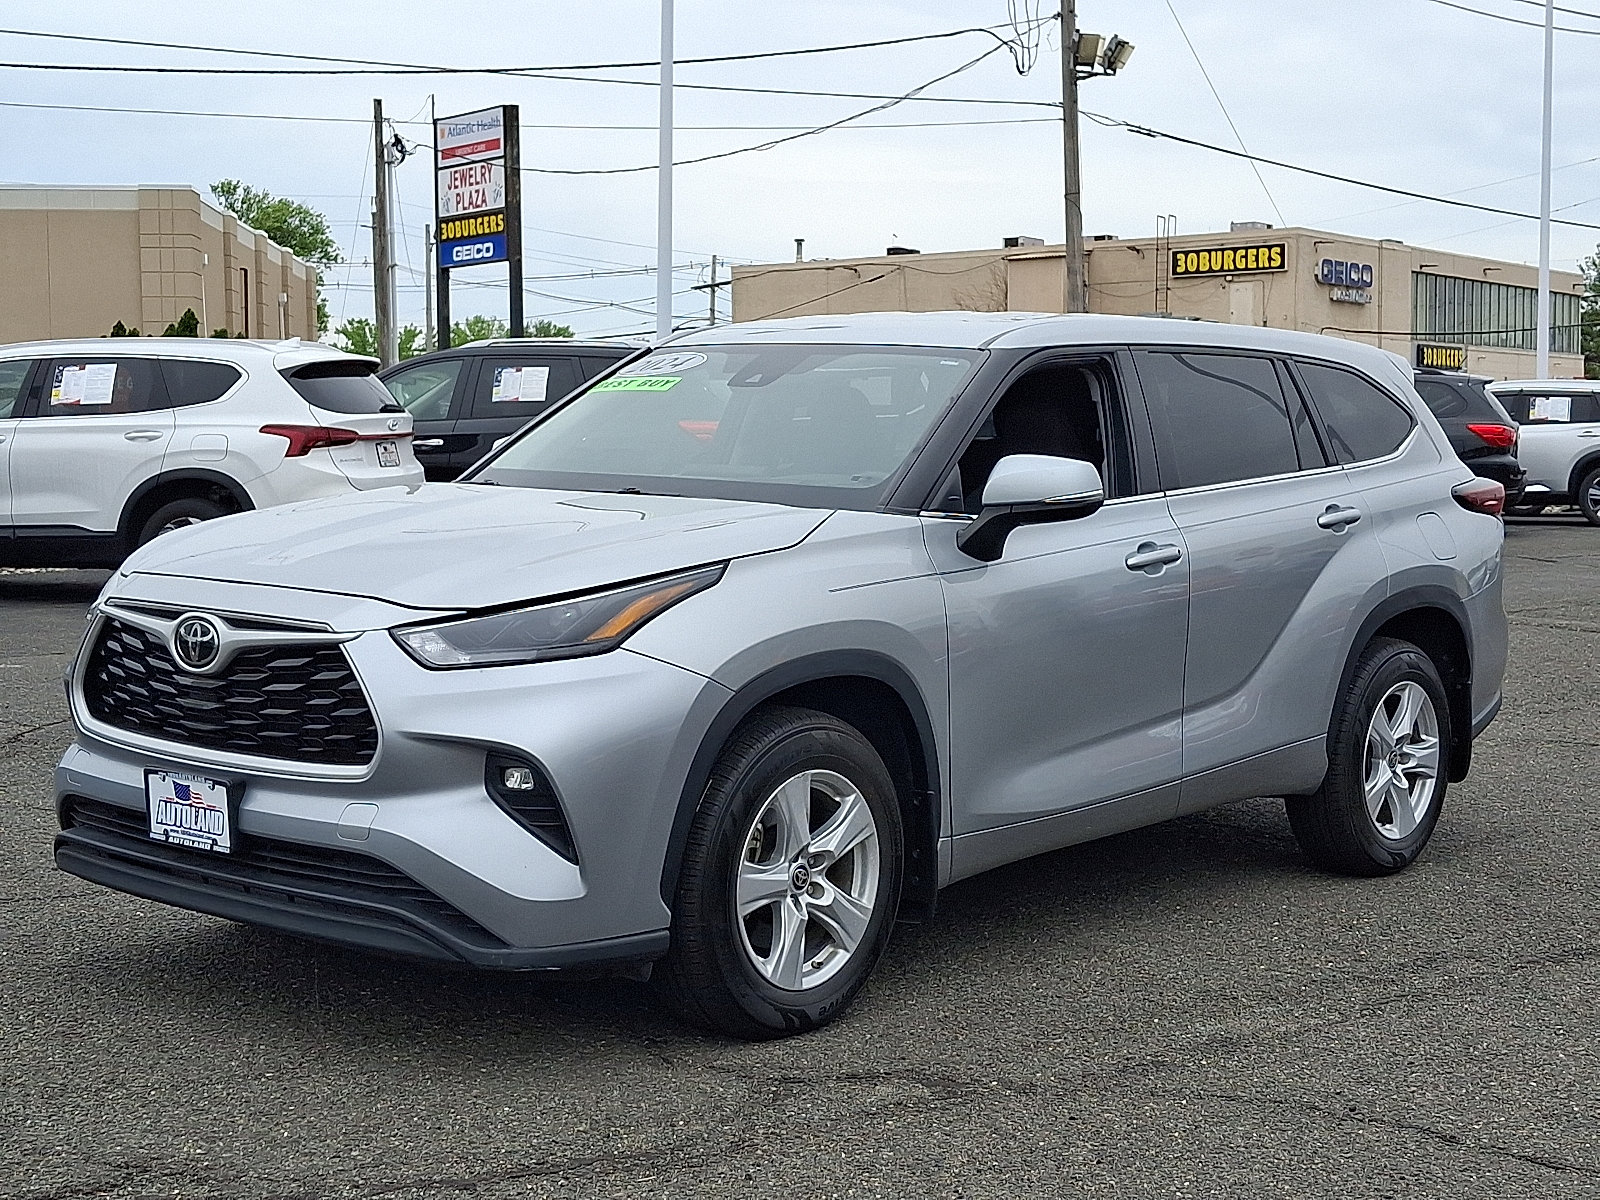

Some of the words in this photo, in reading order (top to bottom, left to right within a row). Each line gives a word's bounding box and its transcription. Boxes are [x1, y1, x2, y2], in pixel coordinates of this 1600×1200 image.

[447, 122, 476, 138] Atlantic
[477, 116, 501, 133] Health
[474, 143, 486, 152] CARE
[447, 163, 493, 191] JEWELRY
[455, 187, 488, 212] PLAZA
[441, 213, 504, 240] 30BURGERS
[452, 242, 494, 262] GEICO
[1176, 246, 1282, 273] 30BURGERS
[1321, 258, 1373, 288] GEICO
[636, 379, 677, 388] BUY
[156, 800, 224, 836] AUTOLAND
[168, 836, 211, 850] AUTOLAND
